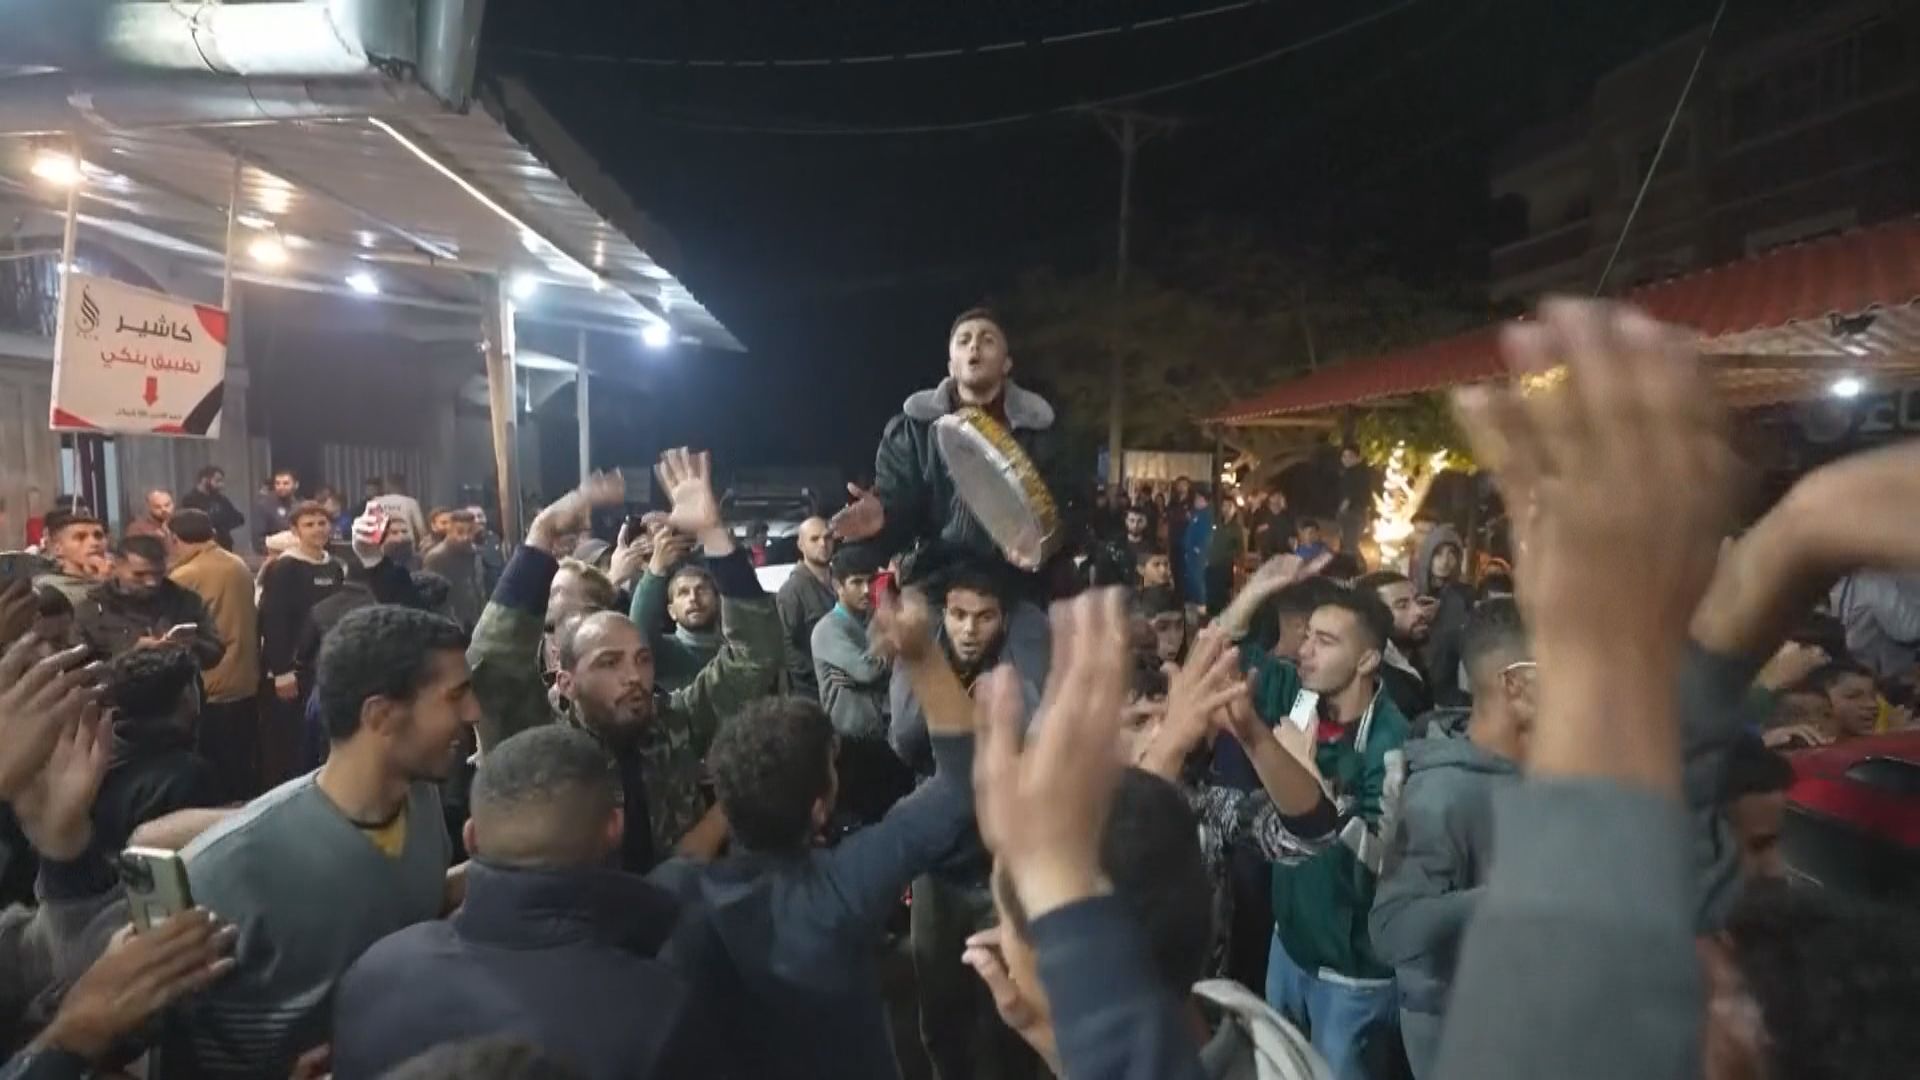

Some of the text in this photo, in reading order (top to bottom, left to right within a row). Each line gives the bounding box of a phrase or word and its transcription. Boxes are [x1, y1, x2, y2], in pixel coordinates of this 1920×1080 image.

[115, 314, 193, 343] كاشير
[100, 347, 201, 374] تطبيق بنكي
